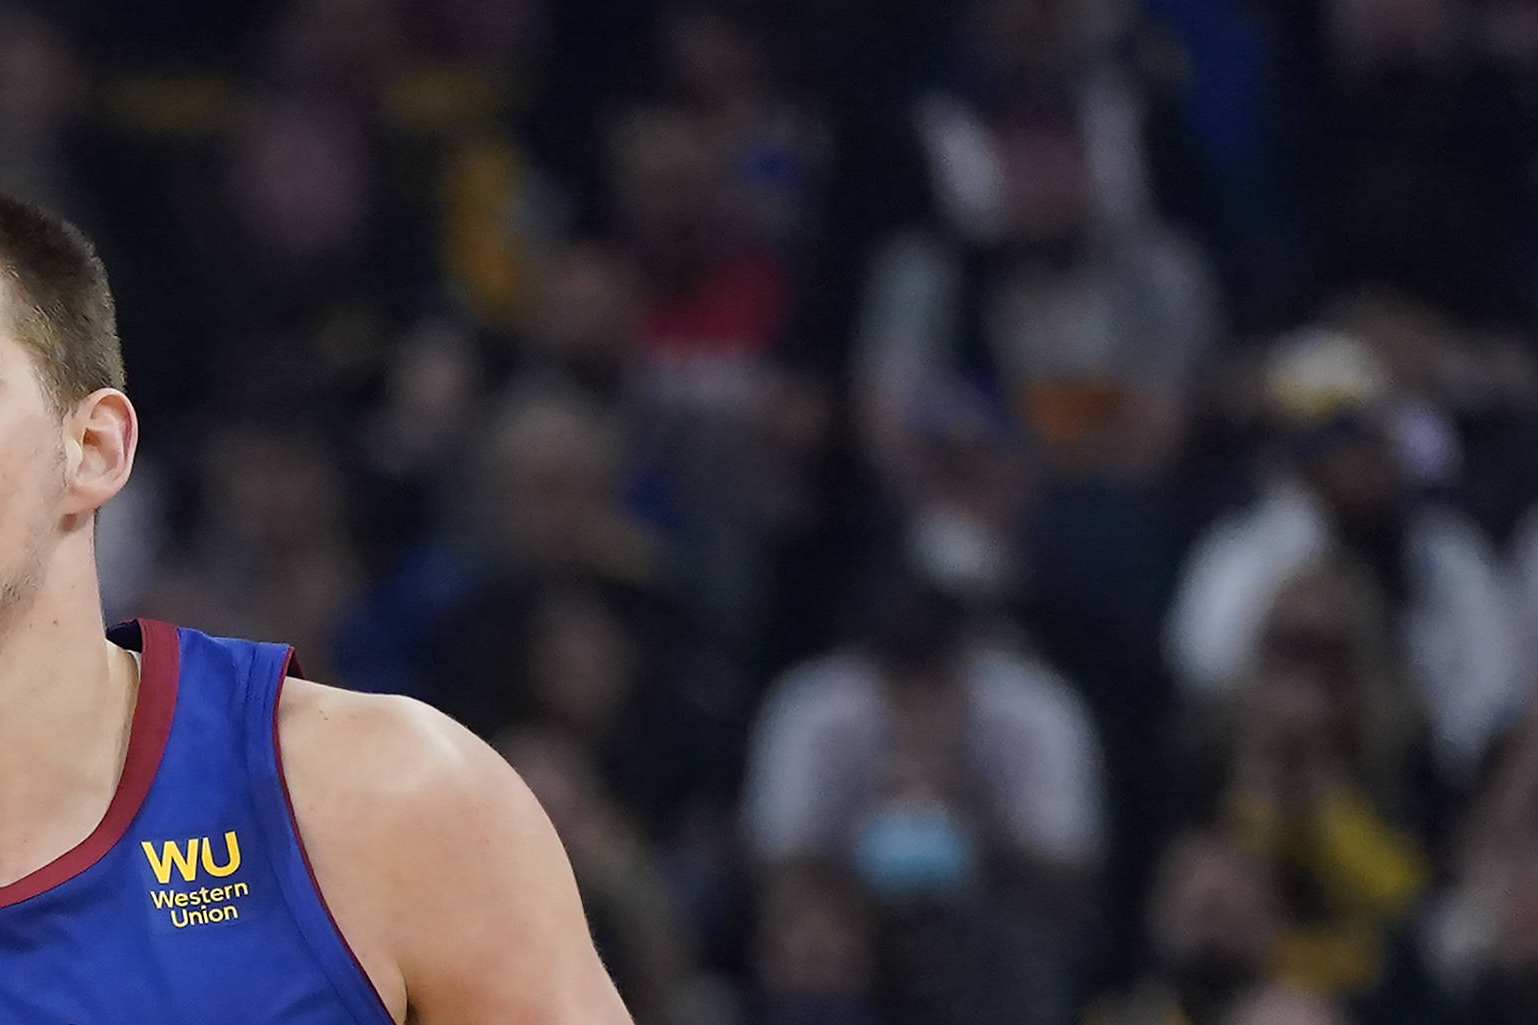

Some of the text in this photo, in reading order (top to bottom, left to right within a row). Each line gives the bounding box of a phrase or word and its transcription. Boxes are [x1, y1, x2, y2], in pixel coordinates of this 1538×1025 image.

[141, 831, 241, 883] WU
[150, 882, 249, 909] Western
[170, 905, 239, 928] Union
